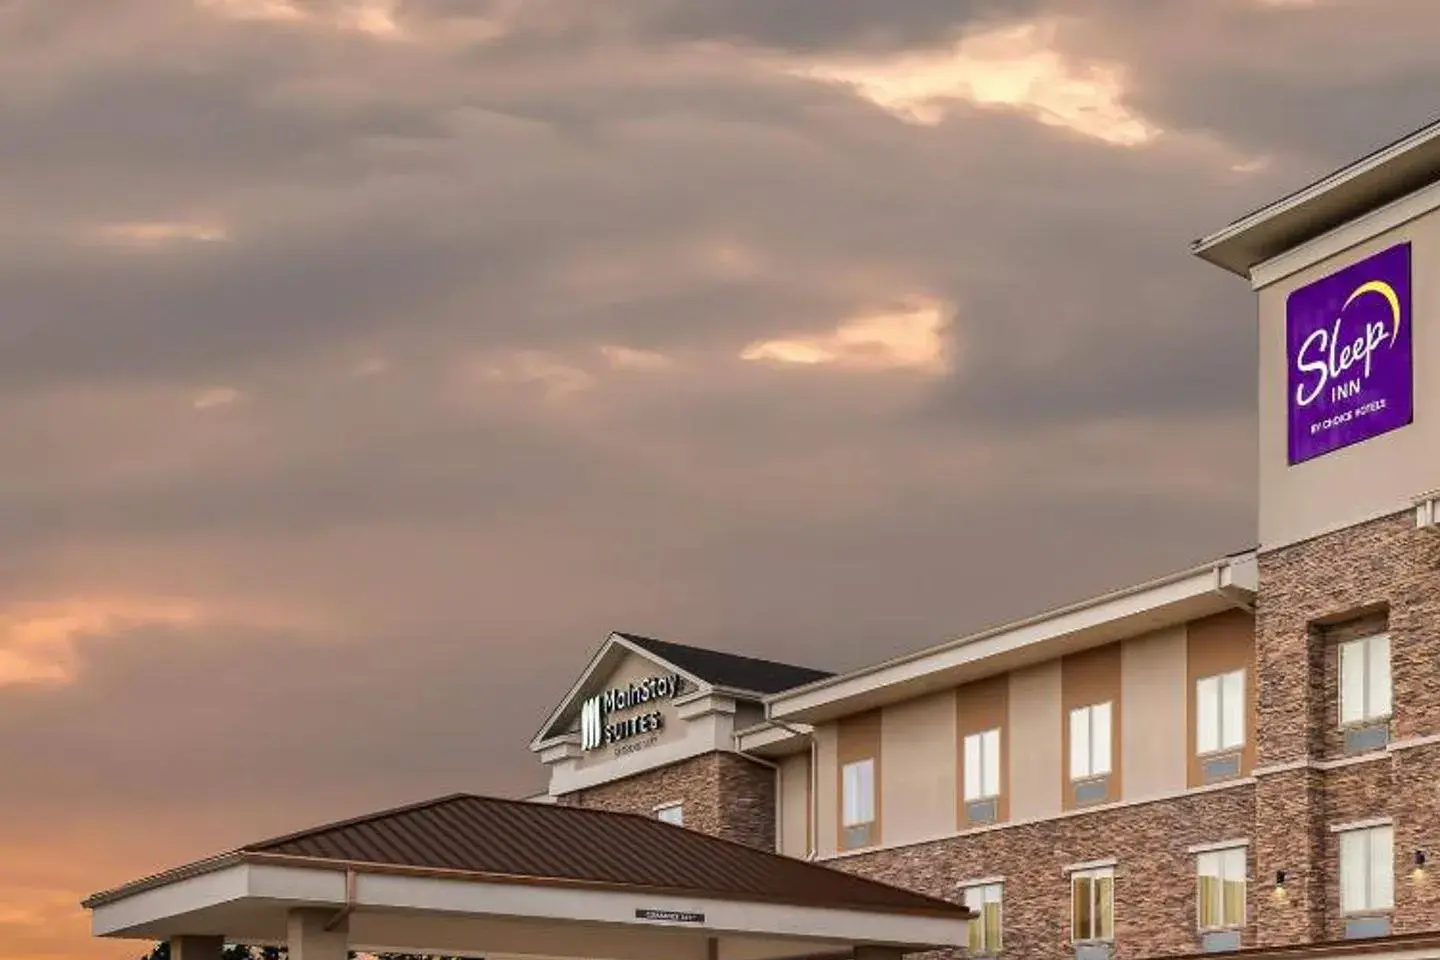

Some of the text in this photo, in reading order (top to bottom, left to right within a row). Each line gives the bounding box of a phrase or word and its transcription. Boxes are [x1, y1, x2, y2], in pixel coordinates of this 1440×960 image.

[1296, 318, 1389, 406] Sleep
[1332, 377, 1361, 402] INN
[1310, 399, 1387, 434] BY CHOICE HOTELS
[604, 674, 679, 713] MainStay
